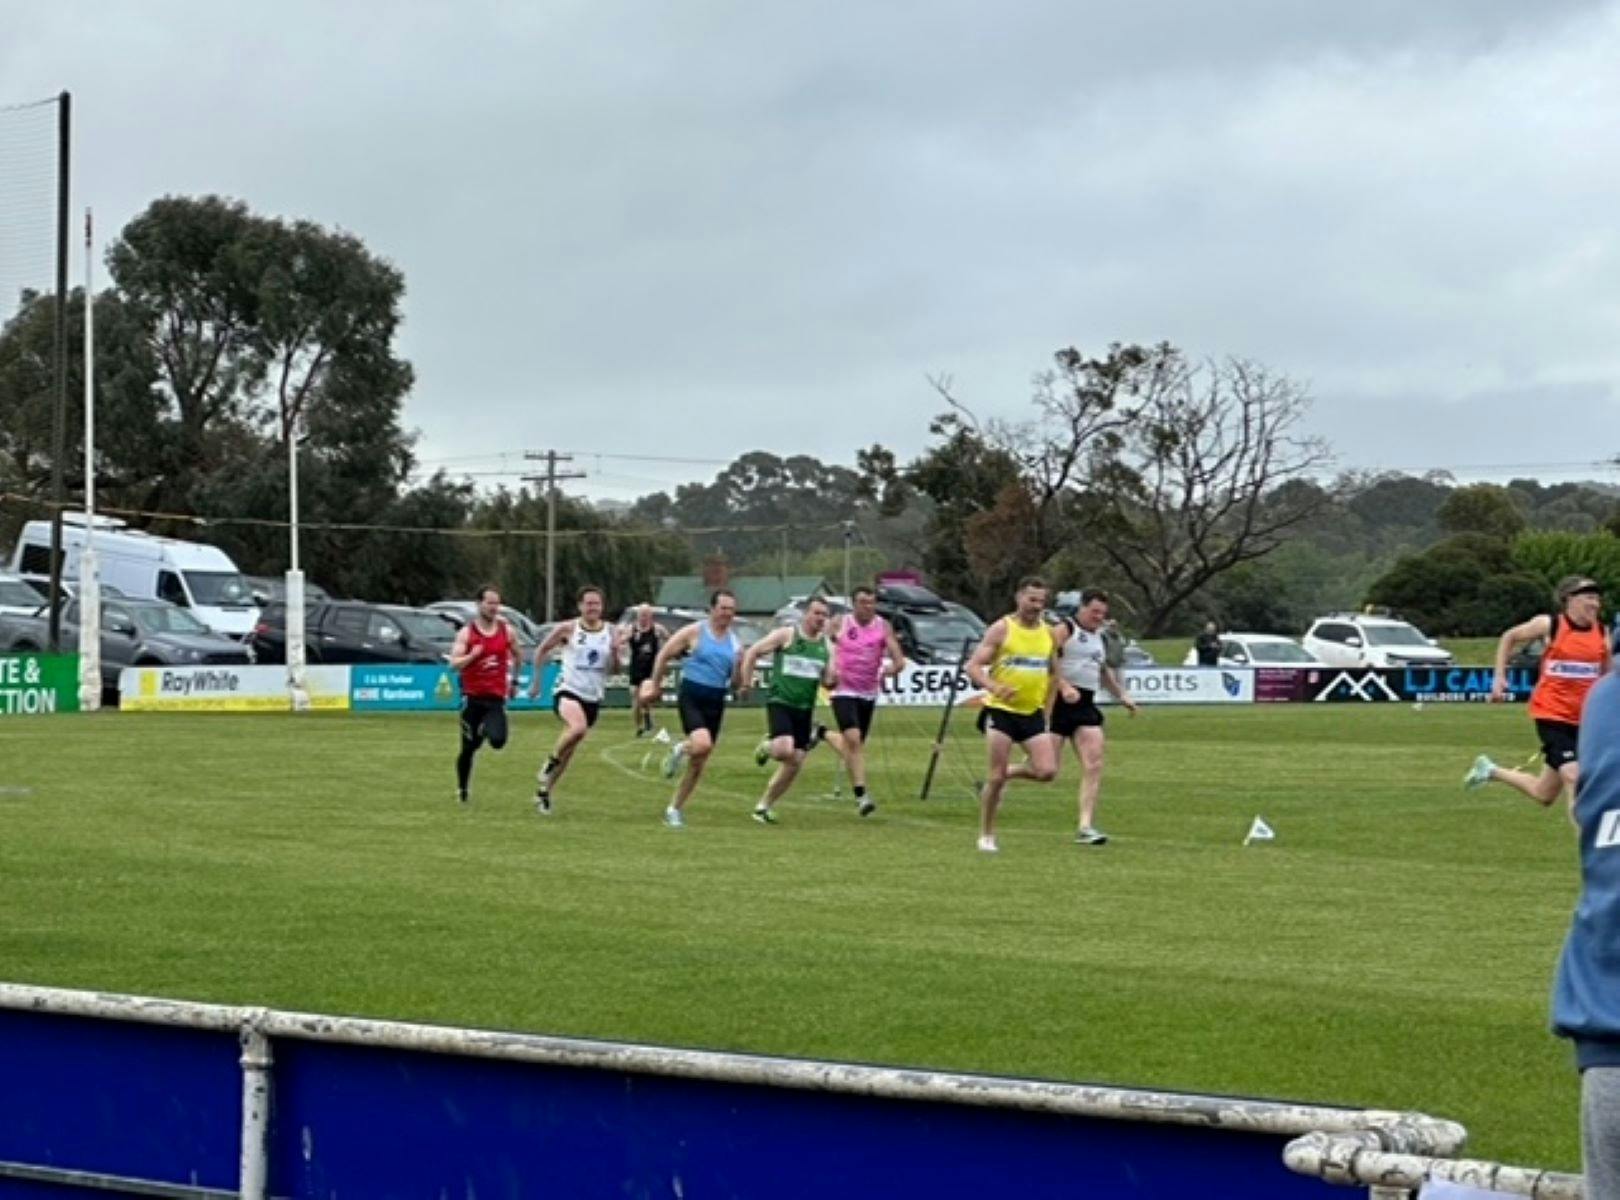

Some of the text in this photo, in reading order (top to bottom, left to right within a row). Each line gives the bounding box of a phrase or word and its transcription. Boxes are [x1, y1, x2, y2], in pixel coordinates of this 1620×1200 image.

[24, 657, 40, 683] &
[1405, 669, 1436, 692] LJ
[1446, 669, 1535, 692] CAHLL
